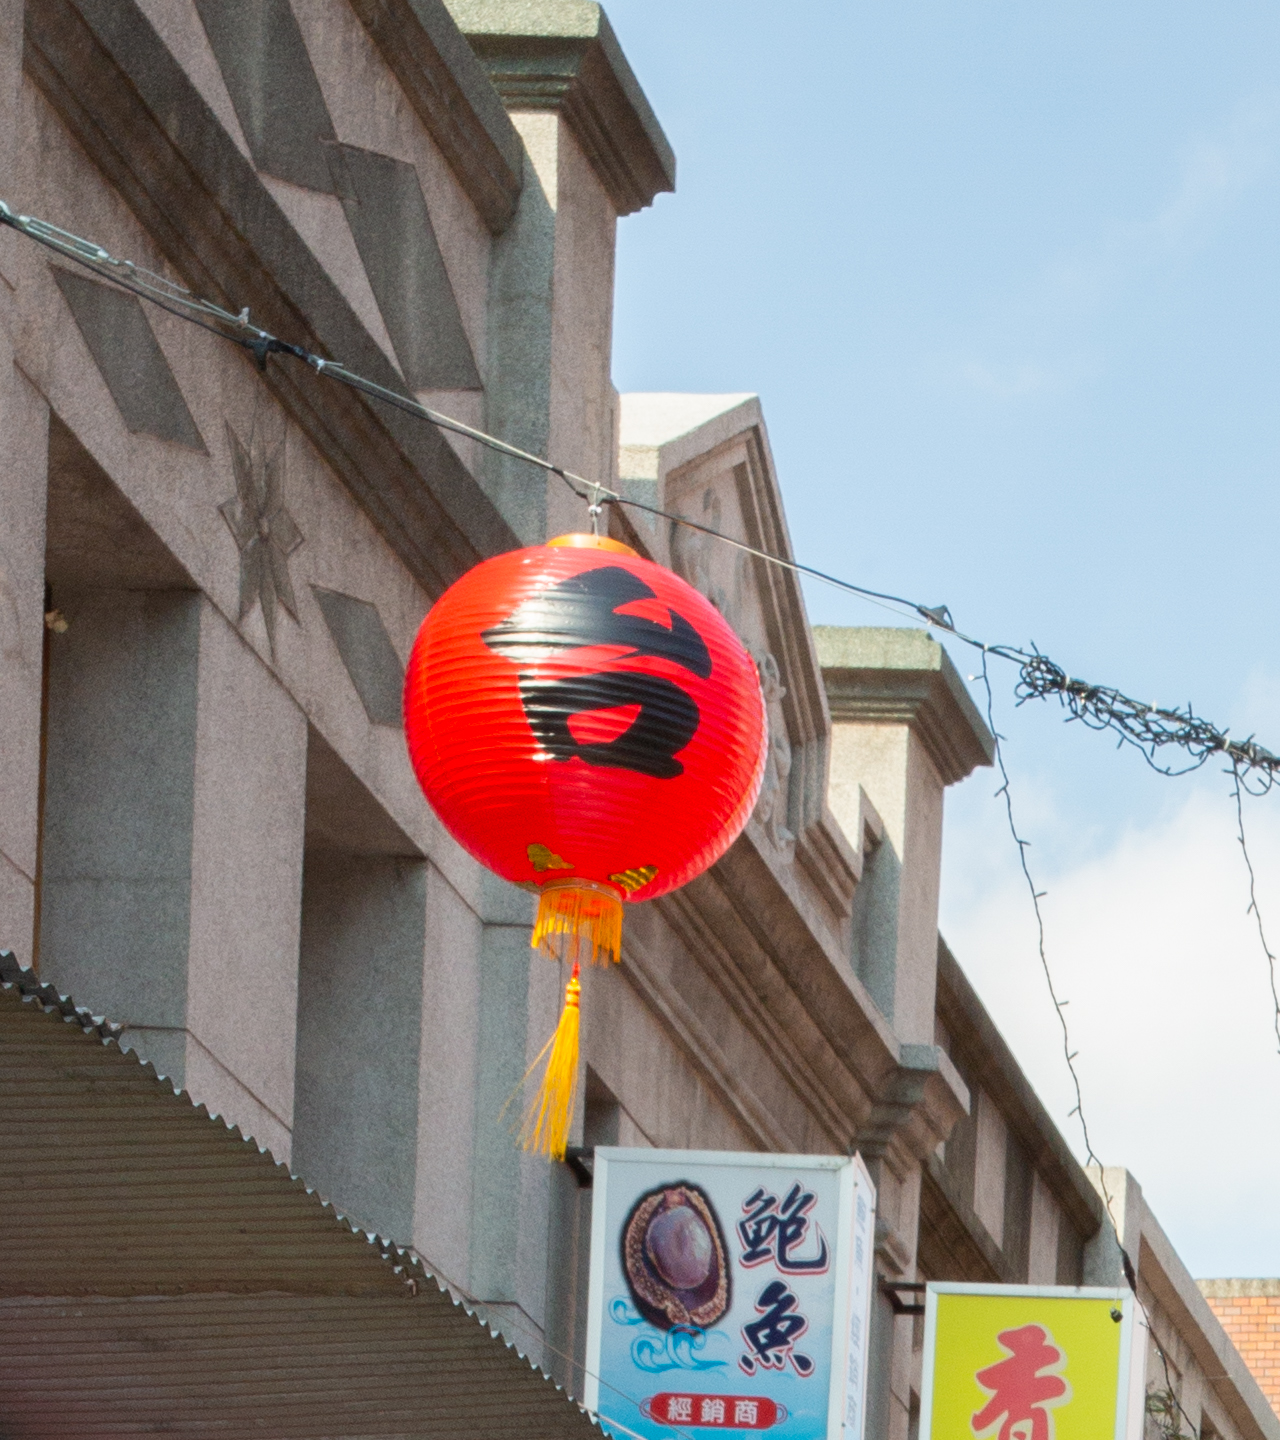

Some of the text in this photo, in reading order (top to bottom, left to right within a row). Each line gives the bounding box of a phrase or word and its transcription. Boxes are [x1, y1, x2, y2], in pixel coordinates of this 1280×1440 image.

[737, 1180, 831, 1377] 鮑魚
[667, 1395, 759, 1427] 經銷商
